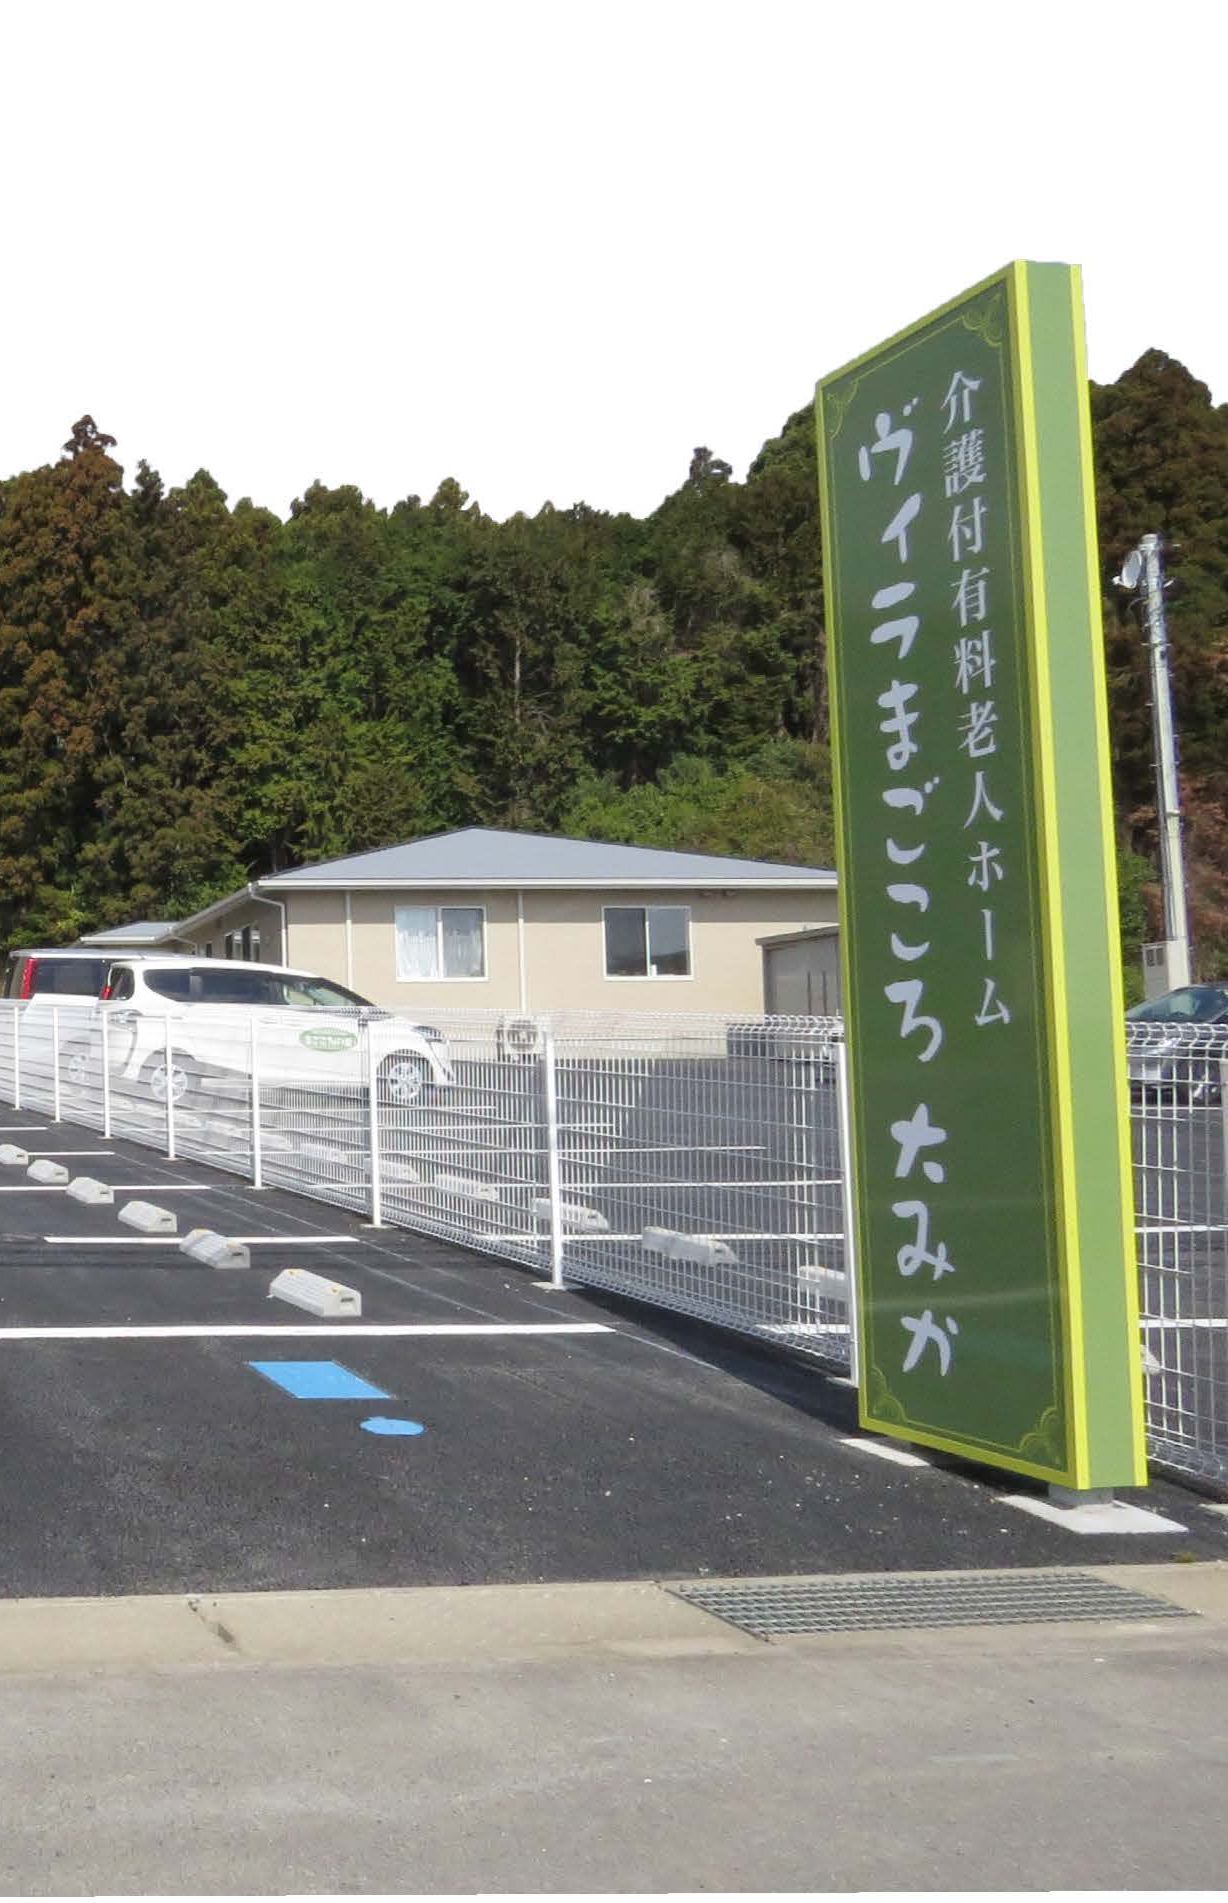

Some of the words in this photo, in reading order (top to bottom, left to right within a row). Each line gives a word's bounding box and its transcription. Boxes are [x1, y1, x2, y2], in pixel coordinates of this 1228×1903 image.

[941, 370, 1012, 1025] 介護付有料老人ホーム
